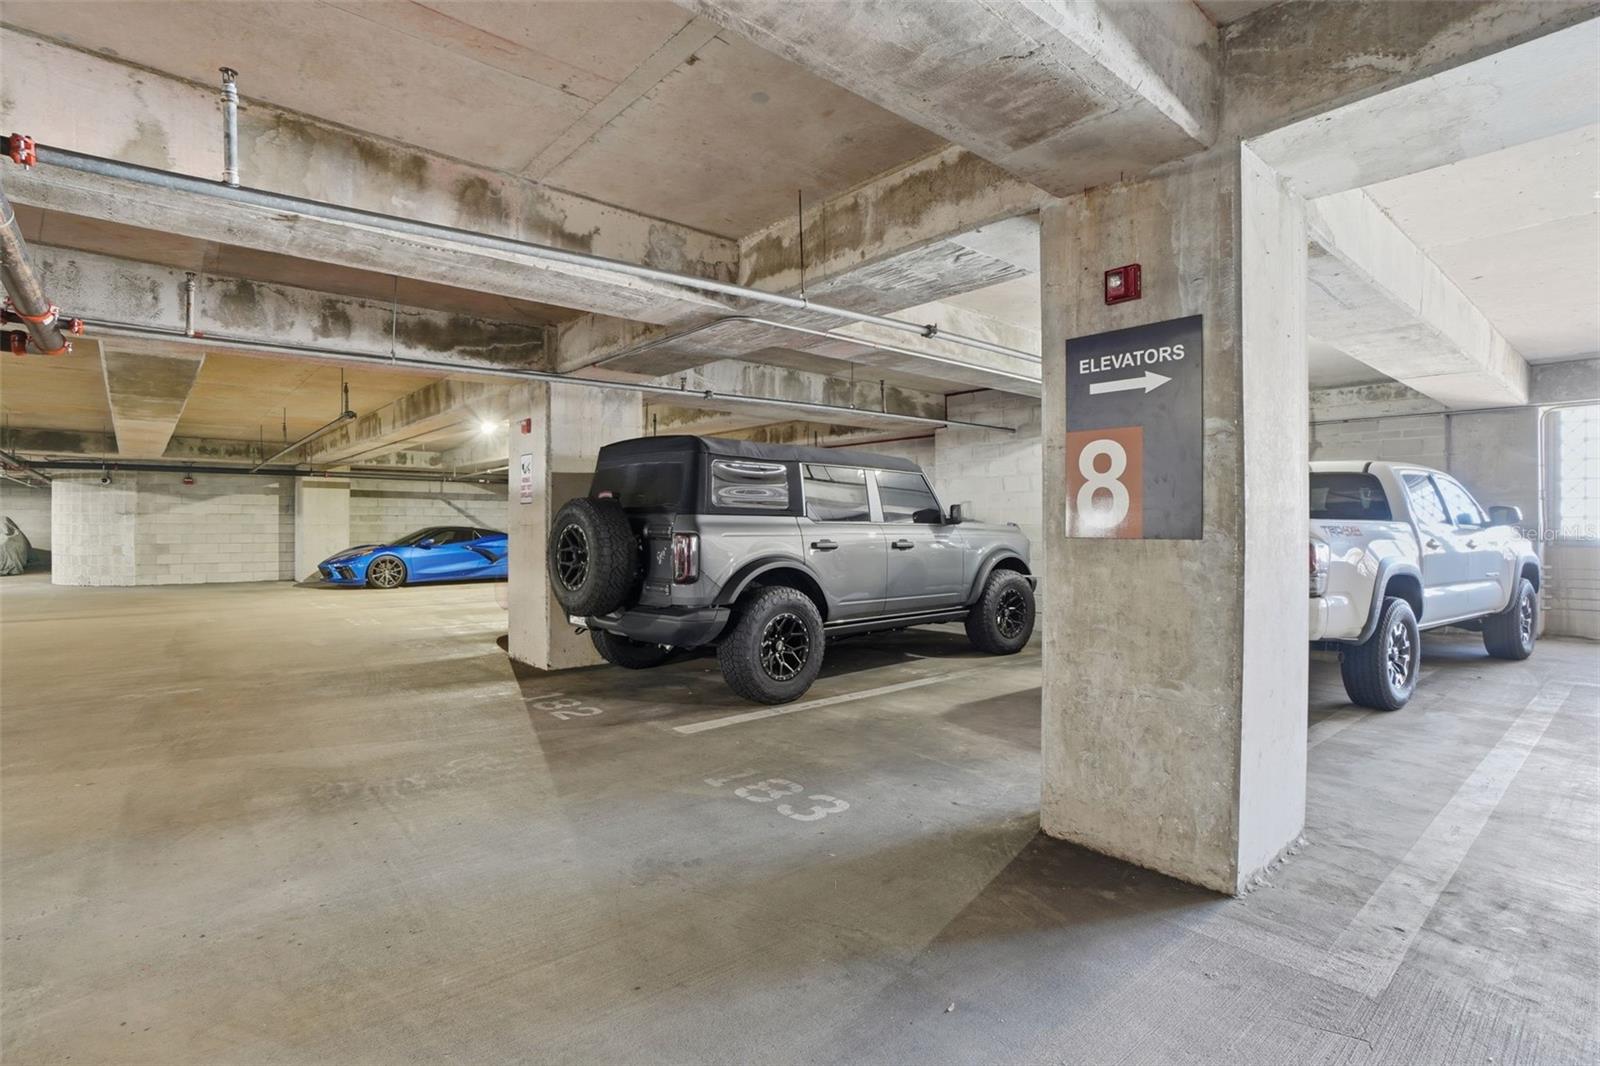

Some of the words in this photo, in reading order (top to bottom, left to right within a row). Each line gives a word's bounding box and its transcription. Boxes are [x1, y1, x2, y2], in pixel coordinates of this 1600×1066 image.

[1079, 344, 1185, 374] ELEVATORS
[1076, 438, 1130, 529] 8
[519, 692, 604, 721] 182
[704, 769, 851, 822] 183
